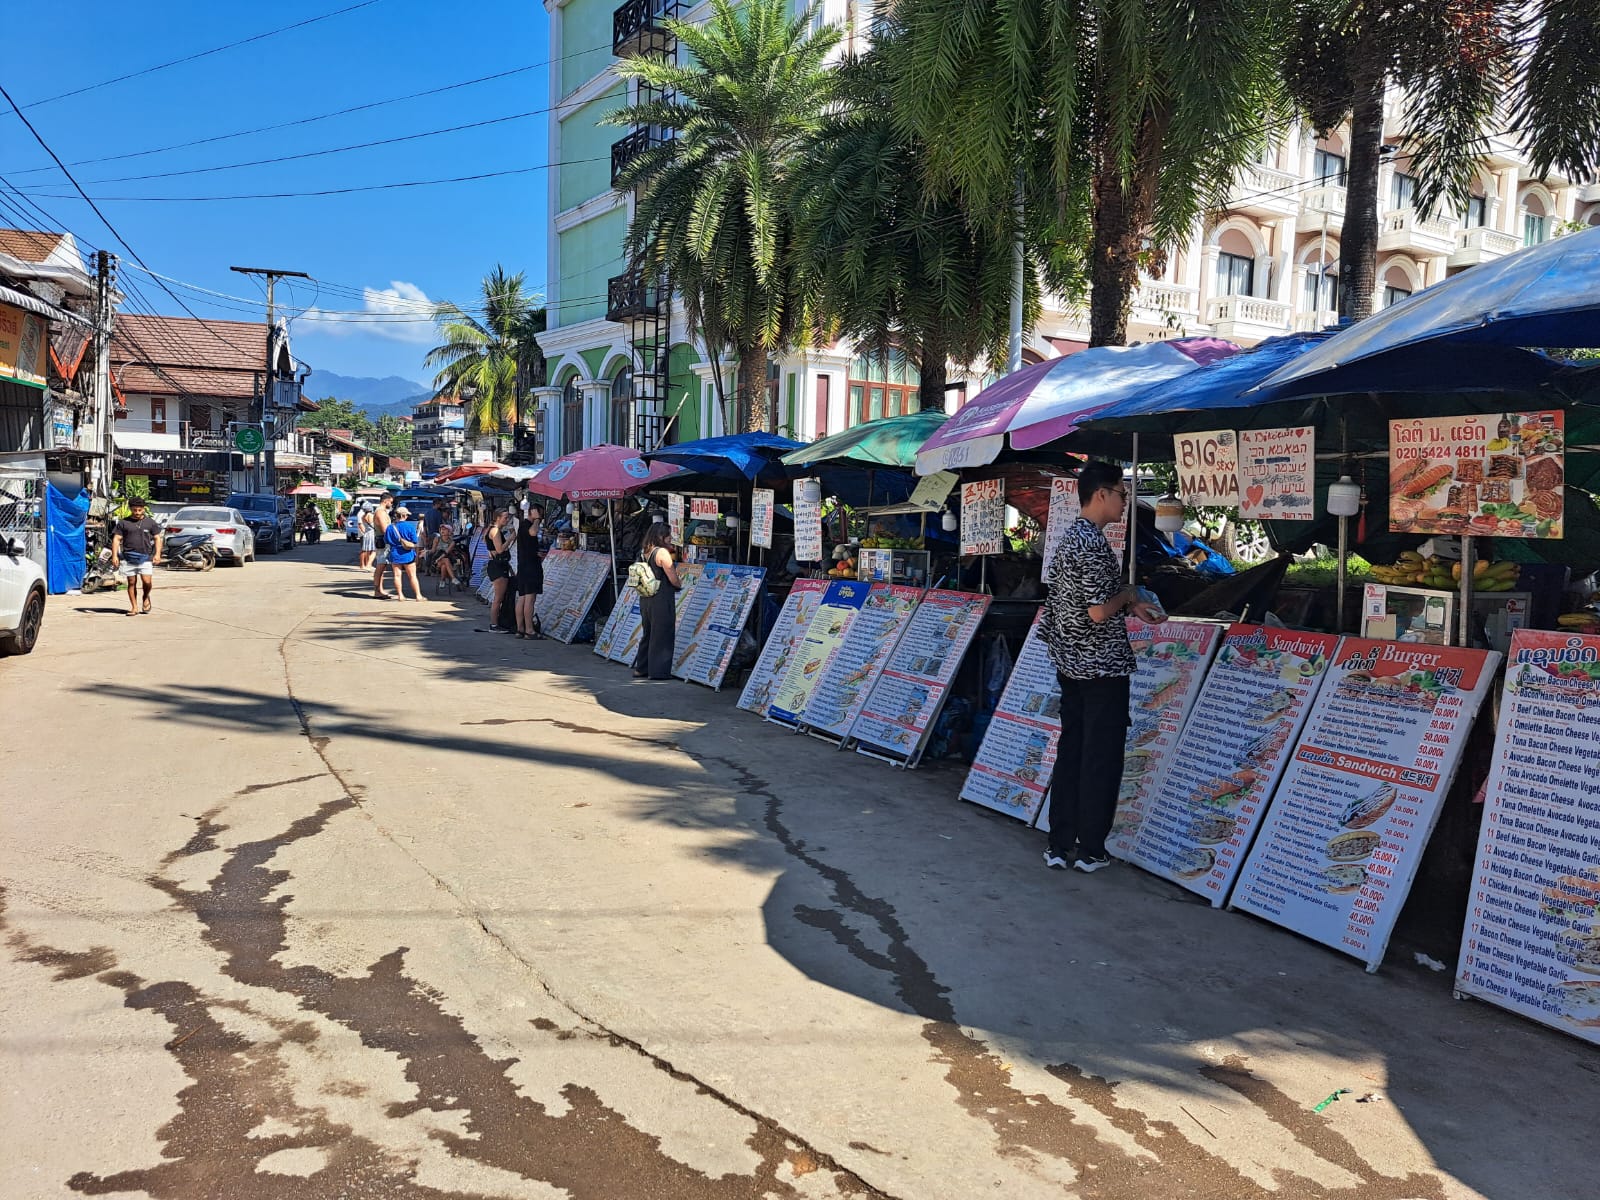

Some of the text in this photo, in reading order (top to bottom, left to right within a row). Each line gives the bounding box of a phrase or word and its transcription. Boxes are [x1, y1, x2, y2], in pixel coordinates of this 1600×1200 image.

[1180, 439, 1217, 469] BIG
[1397, 445, 1485, 459] 020 5424 4811
[1158, 624, 1205, 641] Sandwich
[1271, 635, 1326, 655] Sandwich
[1383, 644, 1441, 671] Burger
[1517, 671, 1593, 690] 1 Chicken Bacon Cheese
[1440, 696, 1459, 706] 50.000
[1514, 687, 1579, 704] 2 Bacon Ham Cheese
[1435, 708, 1455, 717] 50.000
[1511, 703, 1515, 712] 3
[1517, 704, 1532, 715] Beef
[1533, 706, 1553, 718] Chiken
[1556, 710, 1575, 721] Bacon
[1430, 720, 1450, 730] 50.000
[1508, 719, 1589, 740] 4 Omelette Bacon Cheese
[1506, 734, 1572, 755] 5 Tuna Bacon Cheese
[1336, 756, 1397, 778] Sandwich
[1415, 758, 1434, 769] 50.000
[1503, 750, 1582, 773] 6 Avocado Bacon Cheese
[1301, 769, 1360, 788] Chicken Vegetable Garlic
[1501, 766, 1578, 790] 7 Tofu Avocado Omelette
[1319, 785, 1342, 796] Vegetable
[1504, 783, 1527, 796] Chicken
[1530, 788, 1548, 800] Bacon
[1551, 792, 1574, 806] Cheese
[1495, 797, 1574, 823] 9 Tuna Omelette Avocado
[1490, 813, 1587, 844] 10 Tuna Bacon Cheese Avocado
[1488, 828, 1494, 837] 11
[1496, 830, 1510, 840] Beef
[1512, 834, 1525, 846] Ham
[1527, 838, 1546, 852] Bacon
[1548, 843, 1580, 860] Vegetable
[1485, 844, 1491, 854] 12
[1493, 846, 1518, 860] Avocado
[1521, 853, 1543, 868] Cheese
[1545, 859, 1577, 877] Vegetable
[1482, 860, 1592, 899] 13 Hotdog Bacon Cheese Vegetable
[1480, 876, 1594, 917] 14 Chicken Avocado Vegetable Garlic
[1477, 892, 1591, 935] 15 Omelette Cheese Vegetable Garlic
[1475, 907, 1585, 950] 16 Chicekn Cheese Vegetable Garlic
[1472, 923, 1577, 966] 17 Bacon Cheese Vegetable Garlic
[1469, 939, 1567, 981] 18 Ham Cheese Vegetable Garlic
[1466, 955, 1566, 999] 19 Tuna Cheese Vegetable Garlic
[1463, 970, 1561, 1015] 20 Tofu Cheese Vegetable Garlic
